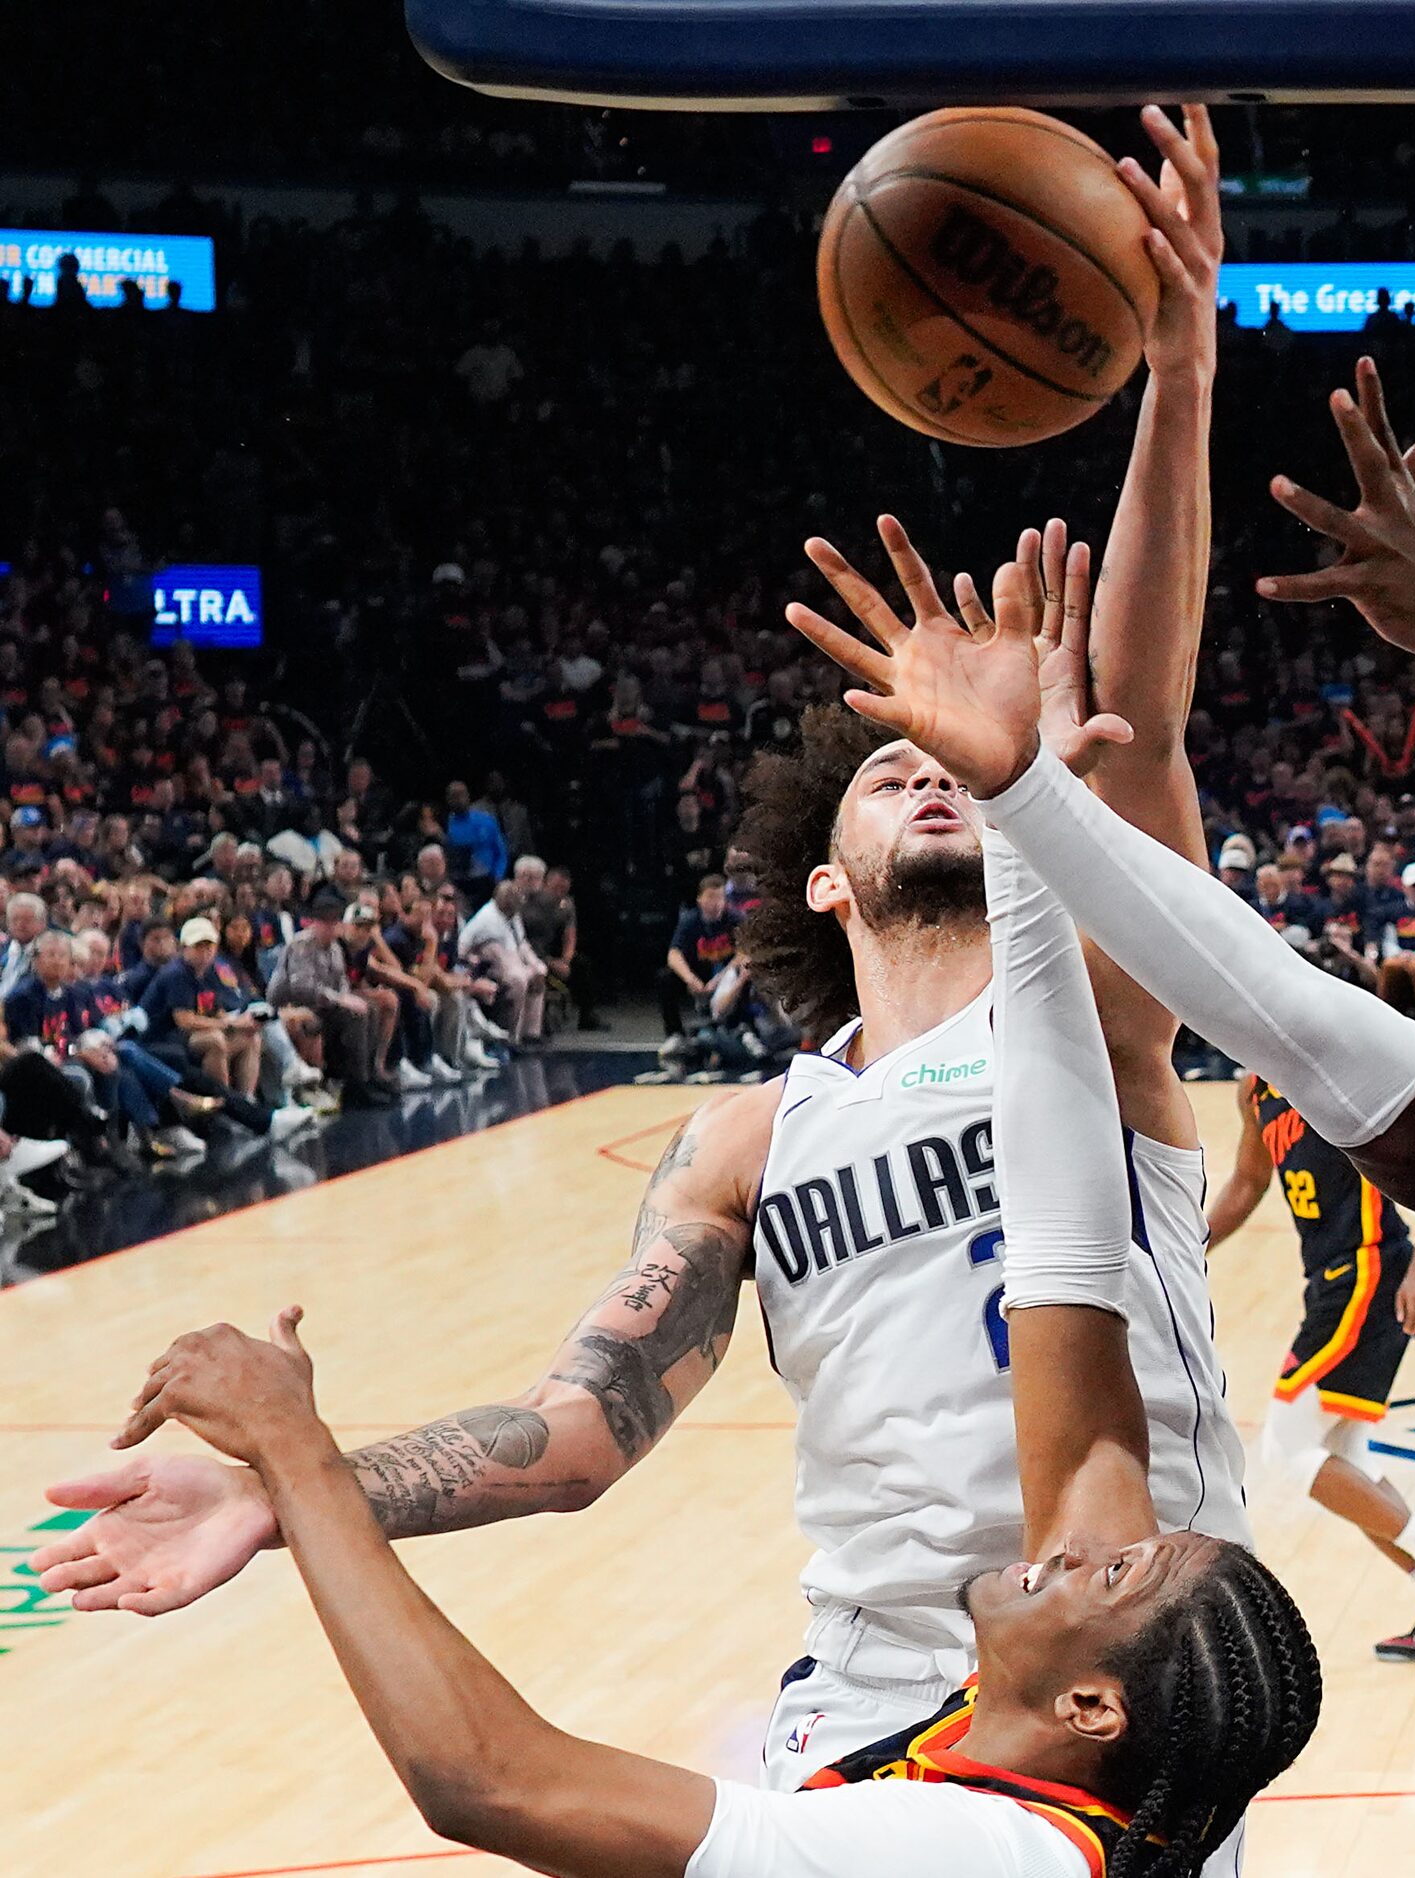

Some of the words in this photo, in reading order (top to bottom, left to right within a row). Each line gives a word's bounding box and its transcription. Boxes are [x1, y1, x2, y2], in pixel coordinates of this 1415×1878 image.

[26, 243, 169, 274] COMERCIAL
[929, 203, 1115, 377] Wilson
[1256, 283, 1309, 314] The
[901, 1058, 986, 1088] chime
[1284, 1169, 1321, 1219] 22
